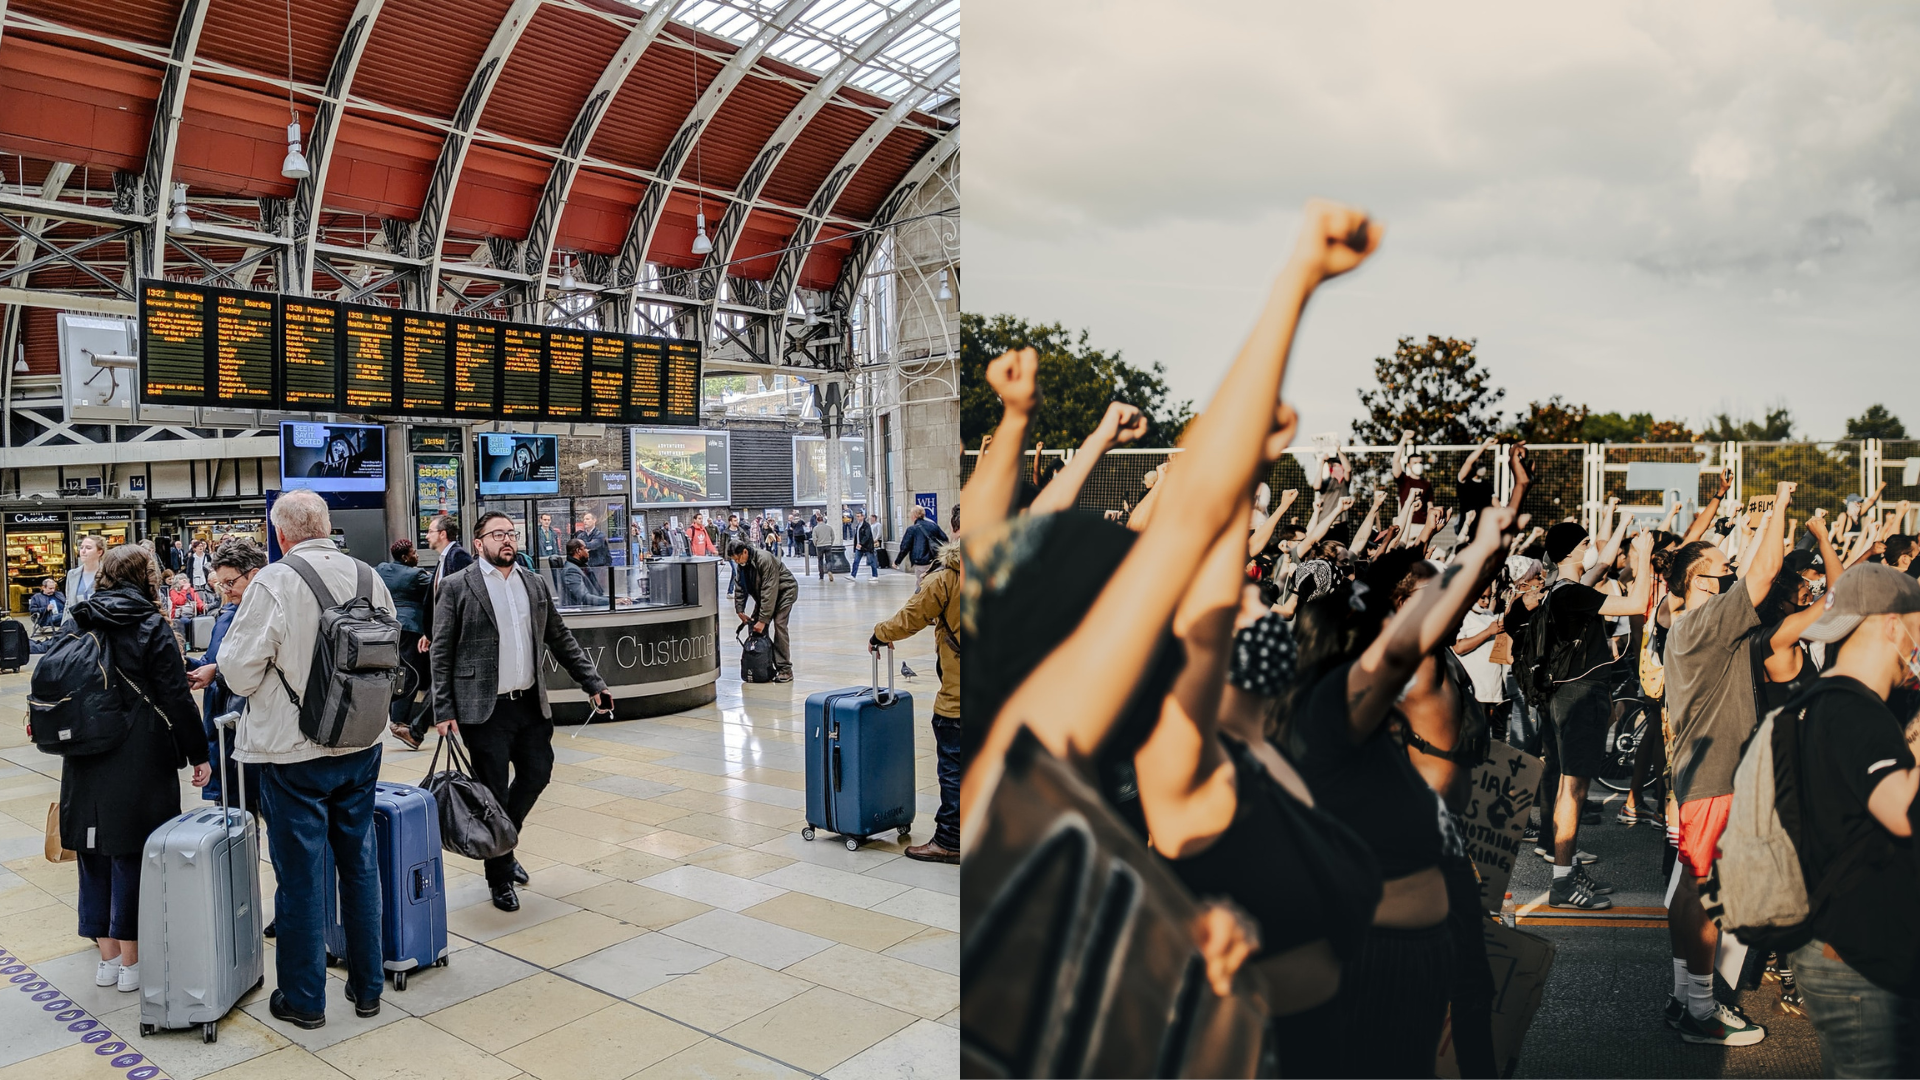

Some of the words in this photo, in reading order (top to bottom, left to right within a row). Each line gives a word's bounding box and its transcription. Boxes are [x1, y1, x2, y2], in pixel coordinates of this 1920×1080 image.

[175, 291, 204, 302] Boarding
[244, 300, 271, 310] Boarding
[218, 306, 242, 315] Cholsey
[307, 307, 334, 316] Preparing
[286, 313, 305, 321] Bristol
[347, 320, 372, 328] Heathrow
[404, 326, 431, 335] Cheltenham
[419, 468, 456, 479] escape
[603, 473, 626, 482] Paddington
[68, 481, 78, 490] 12
[132, 479, 143, 487] 14
[917, 497, 935, 506] WH
[1749, 500, 1773, 513] #BLM
